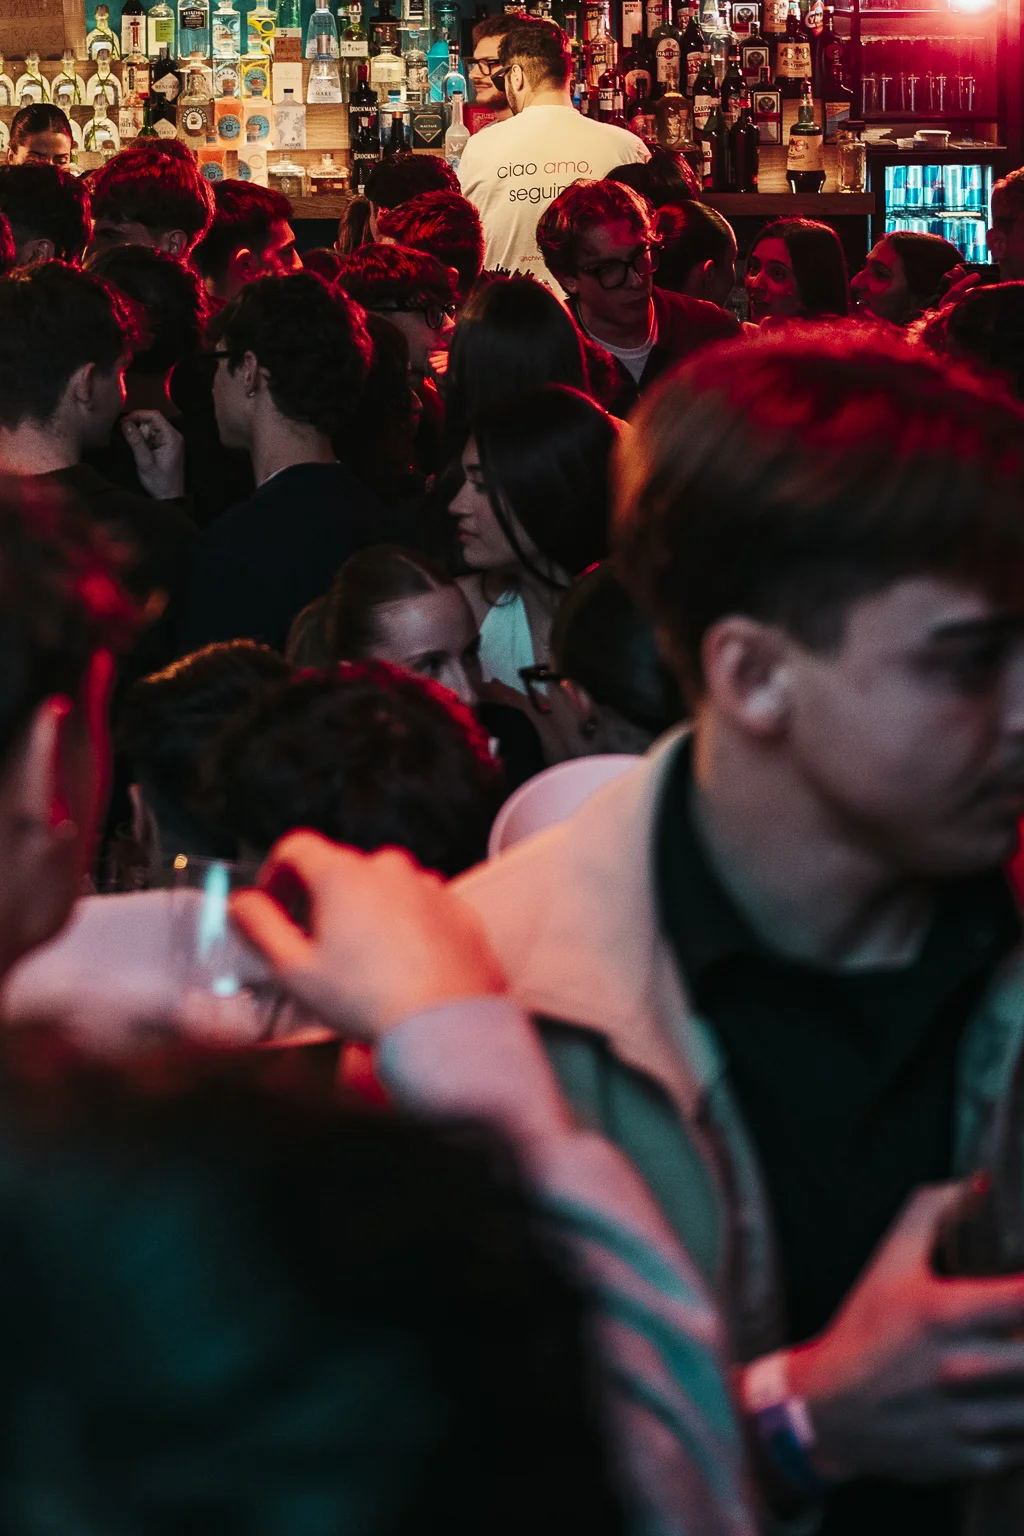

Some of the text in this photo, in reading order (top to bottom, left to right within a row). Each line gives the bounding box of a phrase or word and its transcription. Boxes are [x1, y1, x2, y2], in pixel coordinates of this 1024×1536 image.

[349, 105, 378, 113] BROCKMANS
[497, 160, 593, 179] ciao amo,
